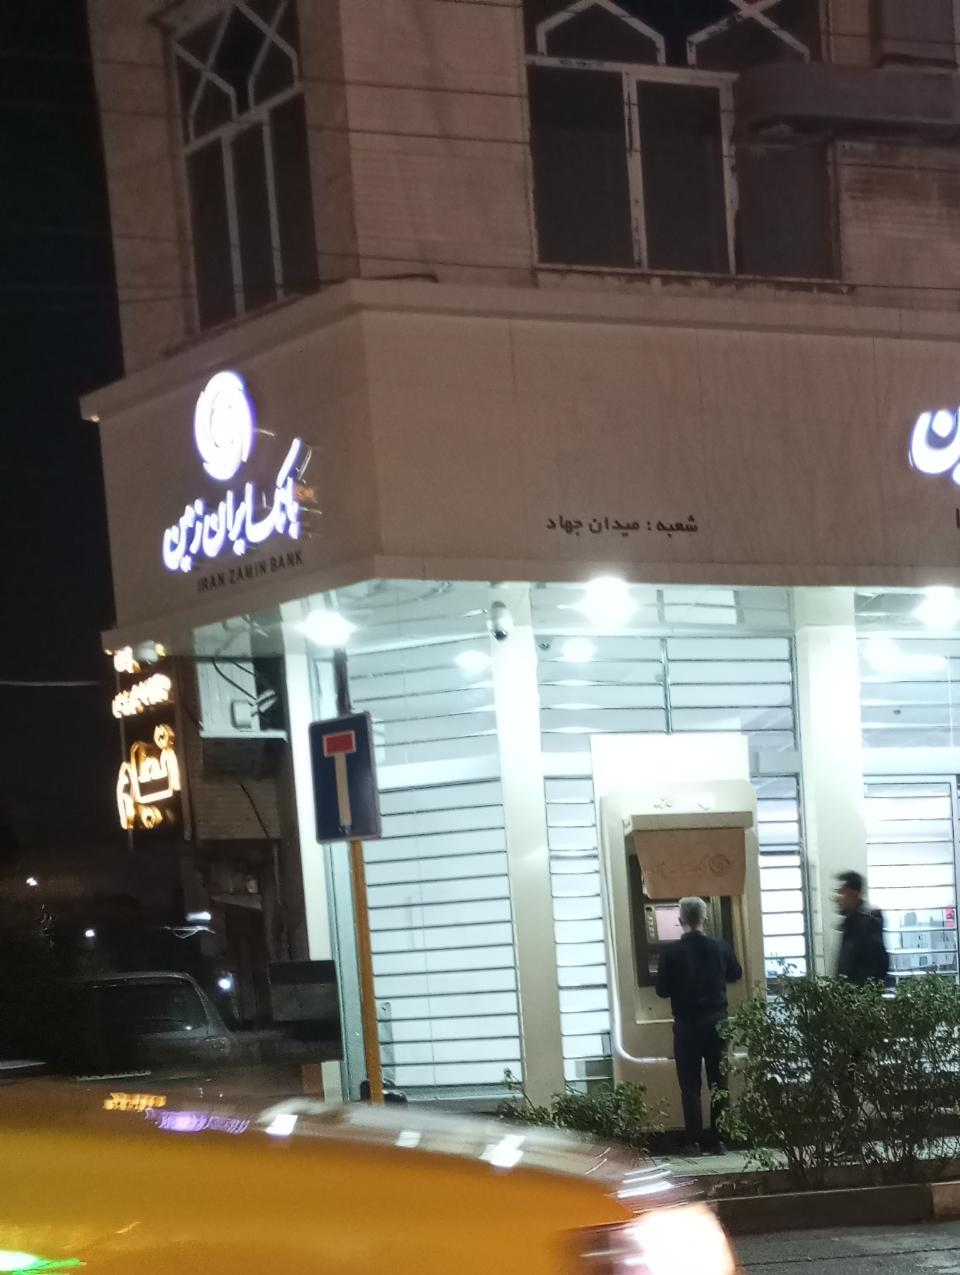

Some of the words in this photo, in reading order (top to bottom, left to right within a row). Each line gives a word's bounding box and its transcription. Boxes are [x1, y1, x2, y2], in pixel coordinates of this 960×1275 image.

[162, 498, 205, 572] زمین
[546, 514, 584, 537] جهاد
[588, 516, 641, 537] میدان
[197, 573, 226, 592] IRAN
[228, 559, 267, 585] ZAMIN
[269, 550, 304, 573] BANK
